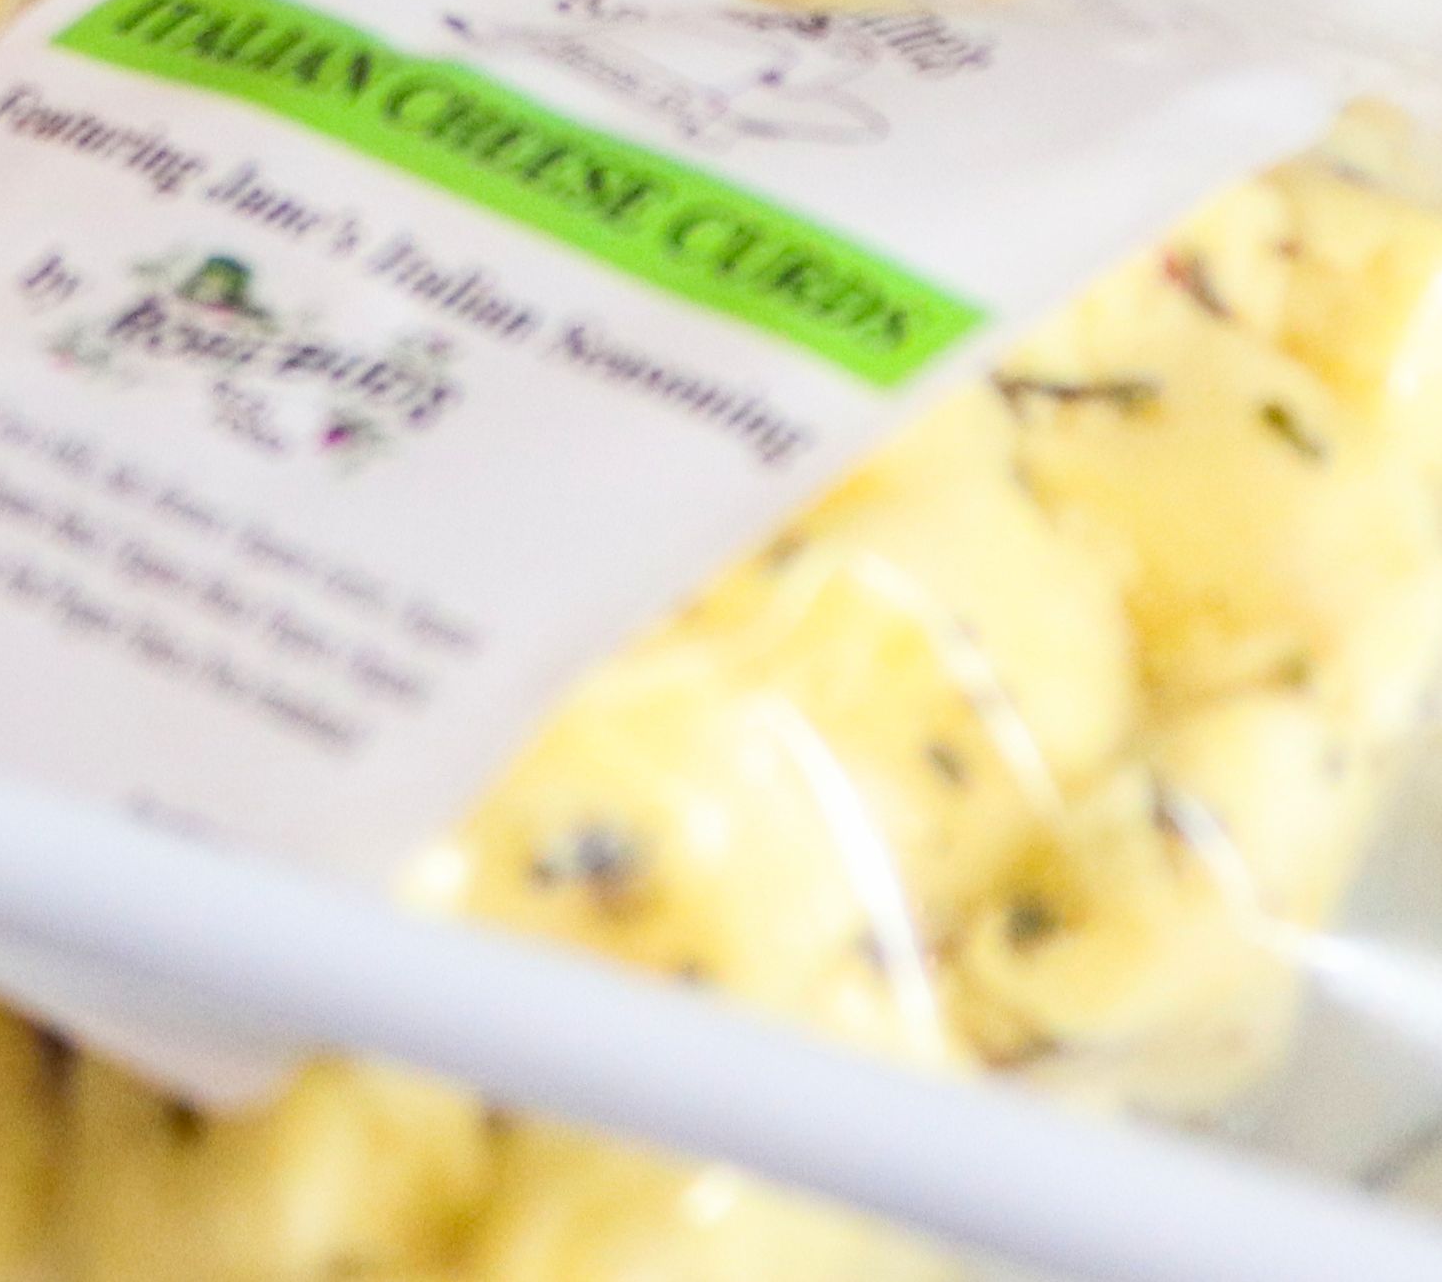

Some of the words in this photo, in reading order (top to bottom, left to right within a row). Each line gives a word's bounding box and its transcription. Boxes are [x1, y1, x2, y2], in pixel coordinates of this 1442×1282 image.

[378, 71, 667, 231] CHEESE
[662, 195, 917, 358] CURDS
[366, 231, 538, 346] Italian
[552, 317, 818, 470] Seasoning
